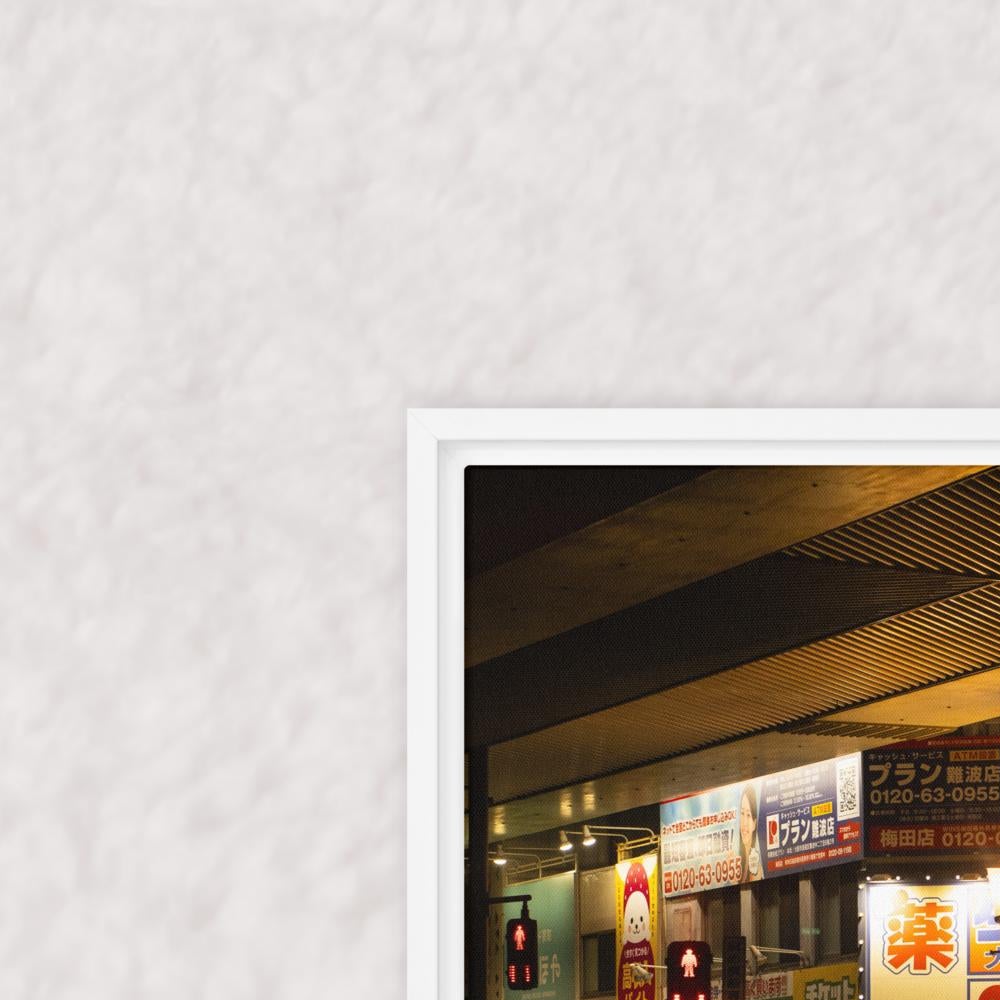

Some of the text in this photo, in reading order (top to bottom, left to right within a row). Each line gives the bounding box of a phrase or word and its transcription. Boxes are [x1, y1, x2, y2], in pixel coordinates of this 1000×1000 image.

[868, 761, 1000, 787] プラン 難波店
[870, 786, 1000, 805] 0120-63-0955
[780, 818, 811, 846] プラン
[811, 817, 835, 839] 難波店
[880, 828, 935, 848] 梅田店
[672, 857, 742, 891] 0120-63-0955
[887, 897, 958, 971] 薬
